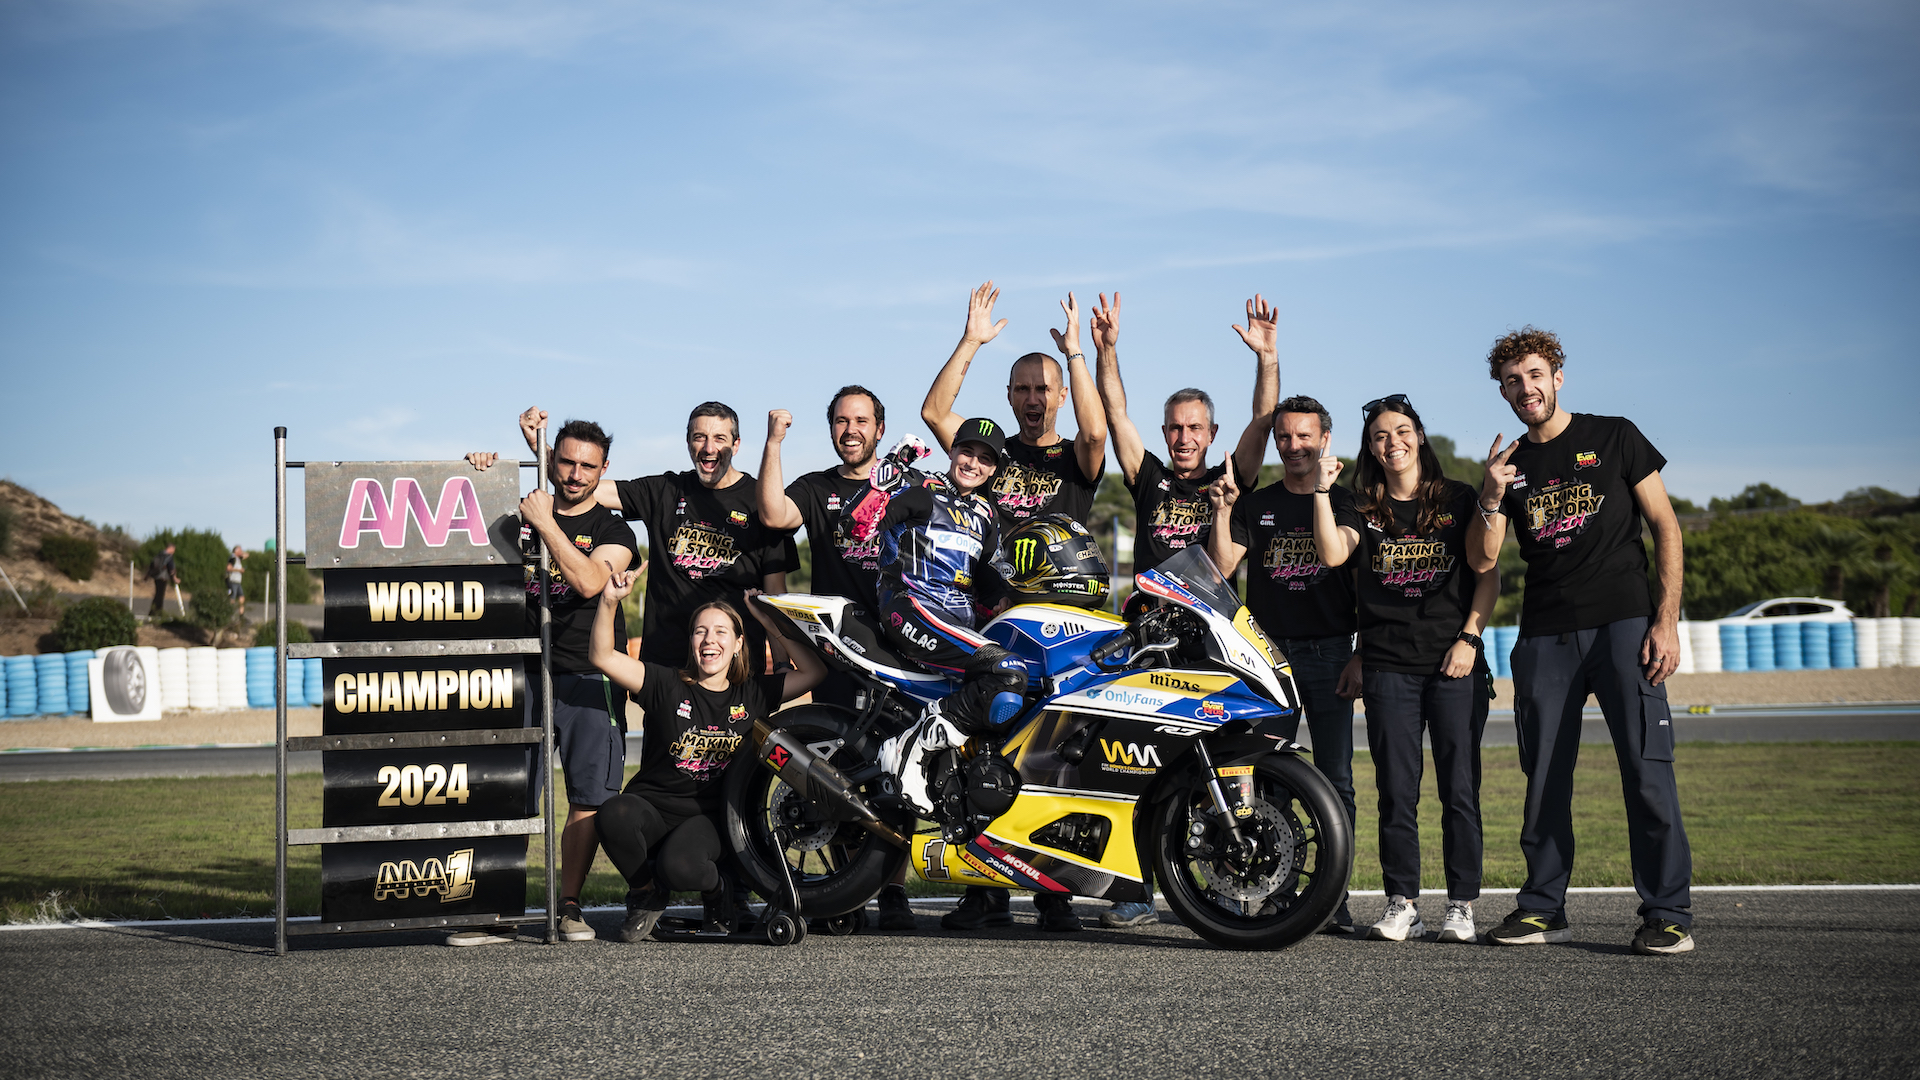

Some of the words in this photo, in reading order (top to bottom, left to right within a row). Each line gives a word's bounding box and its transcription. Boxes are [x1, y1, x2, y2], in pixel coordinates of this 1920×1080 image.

[1527, 484, 1592, 512] MAKING
[339, 476, 490, 548] ANA
[676, 526, 735, 549] MAKING
[1270, 538, 1318, 552] MAKIN
[1379, 542, 1446, 557] MAKING
[673, 553, 723, 570] AGAIN
[1271, 563, 1322, 579] AGAIN
[1053, 582, 1085, 590] MONSTER
[1382, 566, 1437, 586] AGAIN
[366, 581, 485, 622] WORLD
[901, 621, 938, 651] RLAG
[334, 668, 513, 713] CHAMPION
[1105, 690, 1163, 706] OnlyFans
[1202, 700, 1224, 711] Evan
[1221, 767, 1251, 776] PIRELLI
[377, 763, 470, 807] 2024
[1236, 805, 1253, 817] sbs
[922, 838, 951, 880] 1
[1002, 853, 1041, 881] MOTUL
